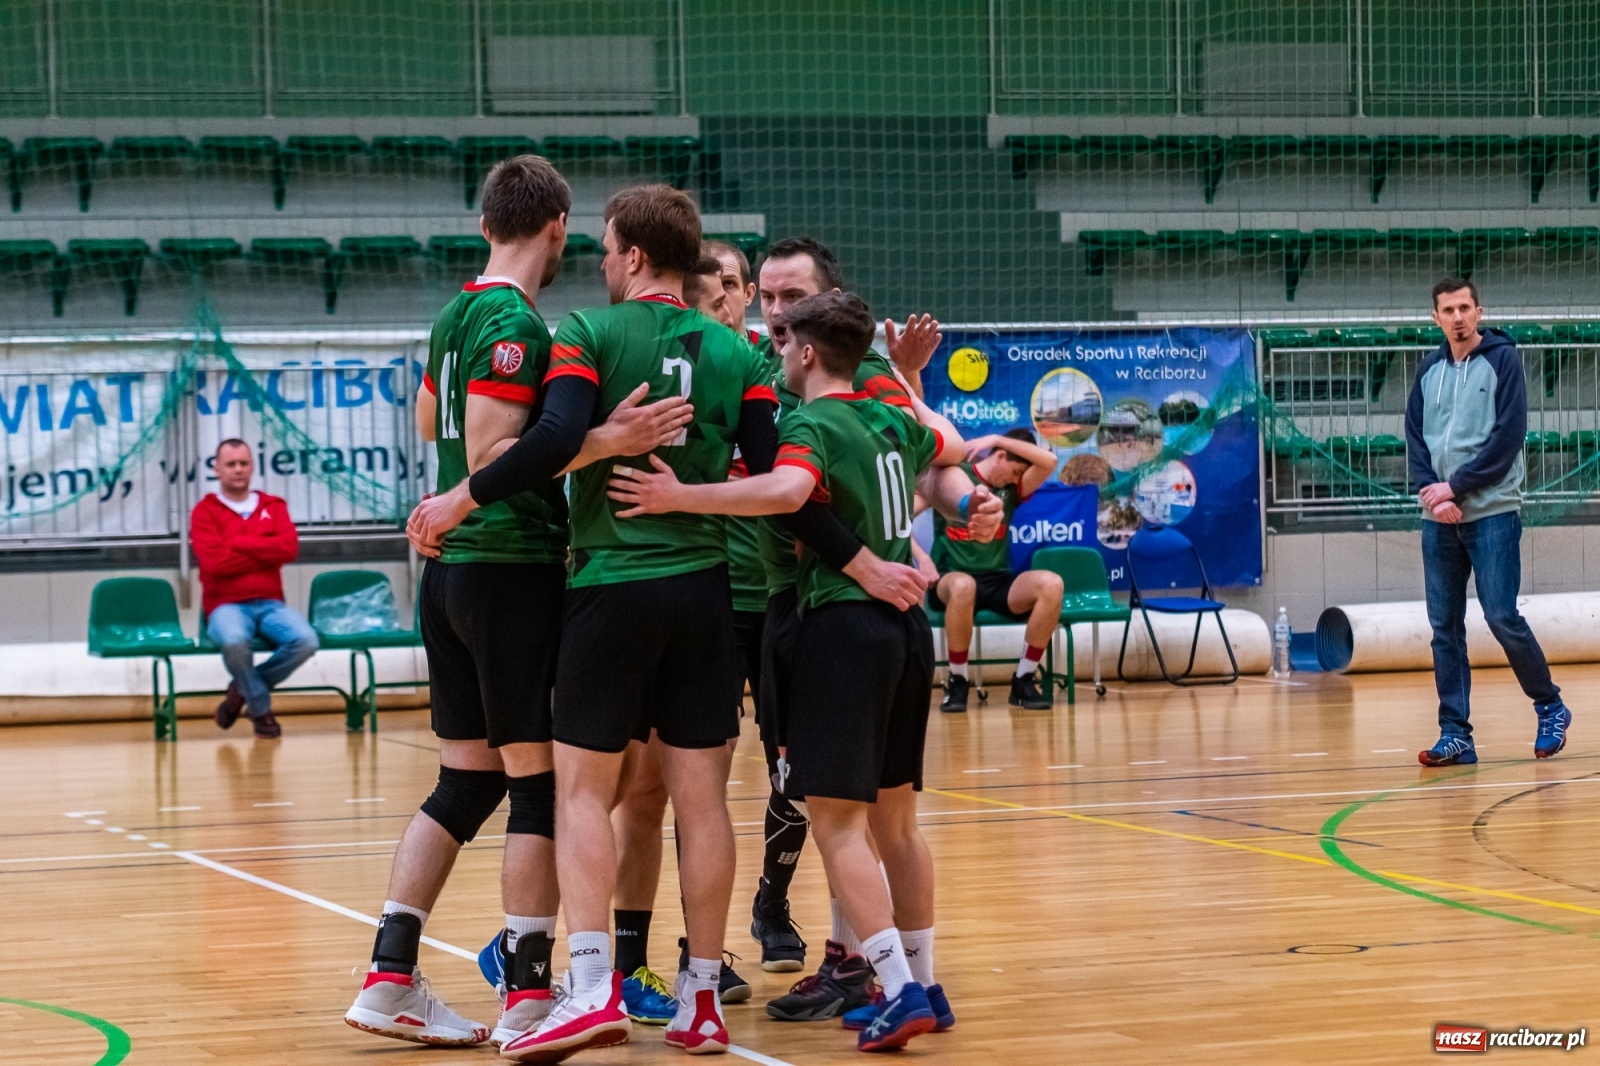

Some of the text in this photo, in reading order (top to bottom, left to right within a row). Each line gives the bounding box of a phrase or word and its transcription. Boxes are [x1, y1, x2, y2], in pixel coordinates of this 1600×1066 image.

[1007, 344, 1207, 362] Ośrodek Sportu i Rekreacji
[1115, 365, 1206, 380] w Raciborzu
[160, 441, 425, 485] wsieramy,
[876, 451, 913, 541] 10
